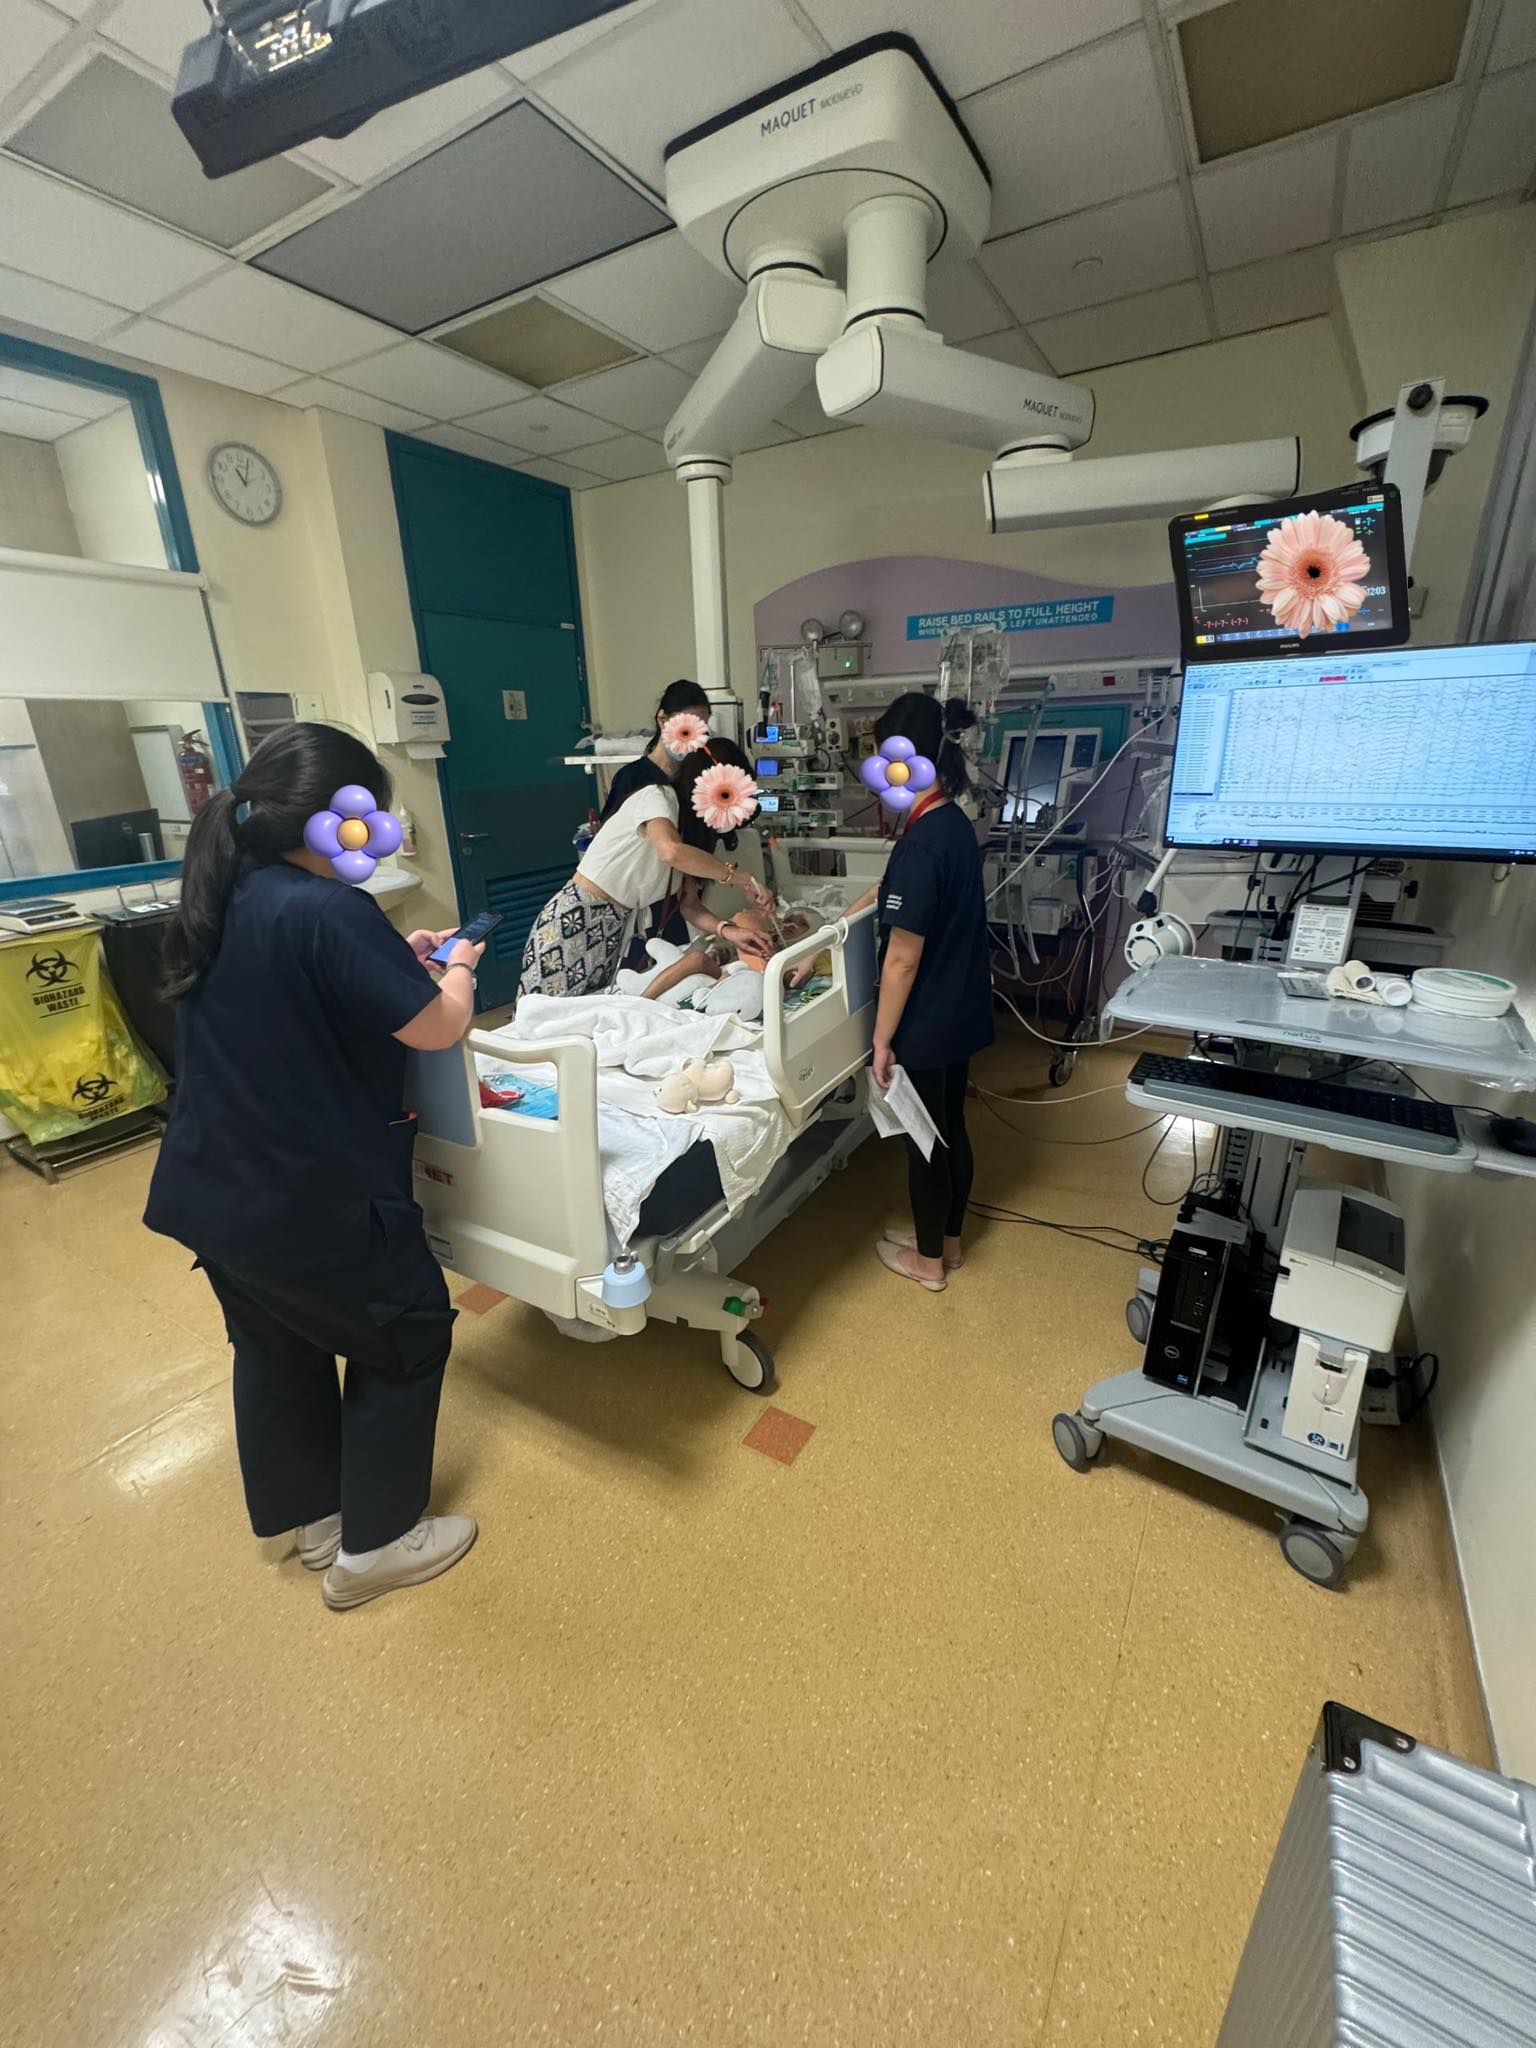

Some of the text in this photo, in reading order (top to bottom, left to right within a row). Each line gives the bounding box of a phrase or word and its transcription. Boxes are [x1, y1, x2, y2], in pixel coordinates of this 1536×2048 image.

[760, 98, 816, 136] MAQUET
[1022, 398, 1058, 418] MAQUET
[918, 601, 1099, 627] RAISE BED RAILS TO FULL HEIGHT
[1010, 619, 1033, 628] LEFT
[1035, 613, 1098, 626] UNATTENDED
[33, 986, 86, 1005] BIOHAZARD
[47, 997, 80, 1012] WASTE
